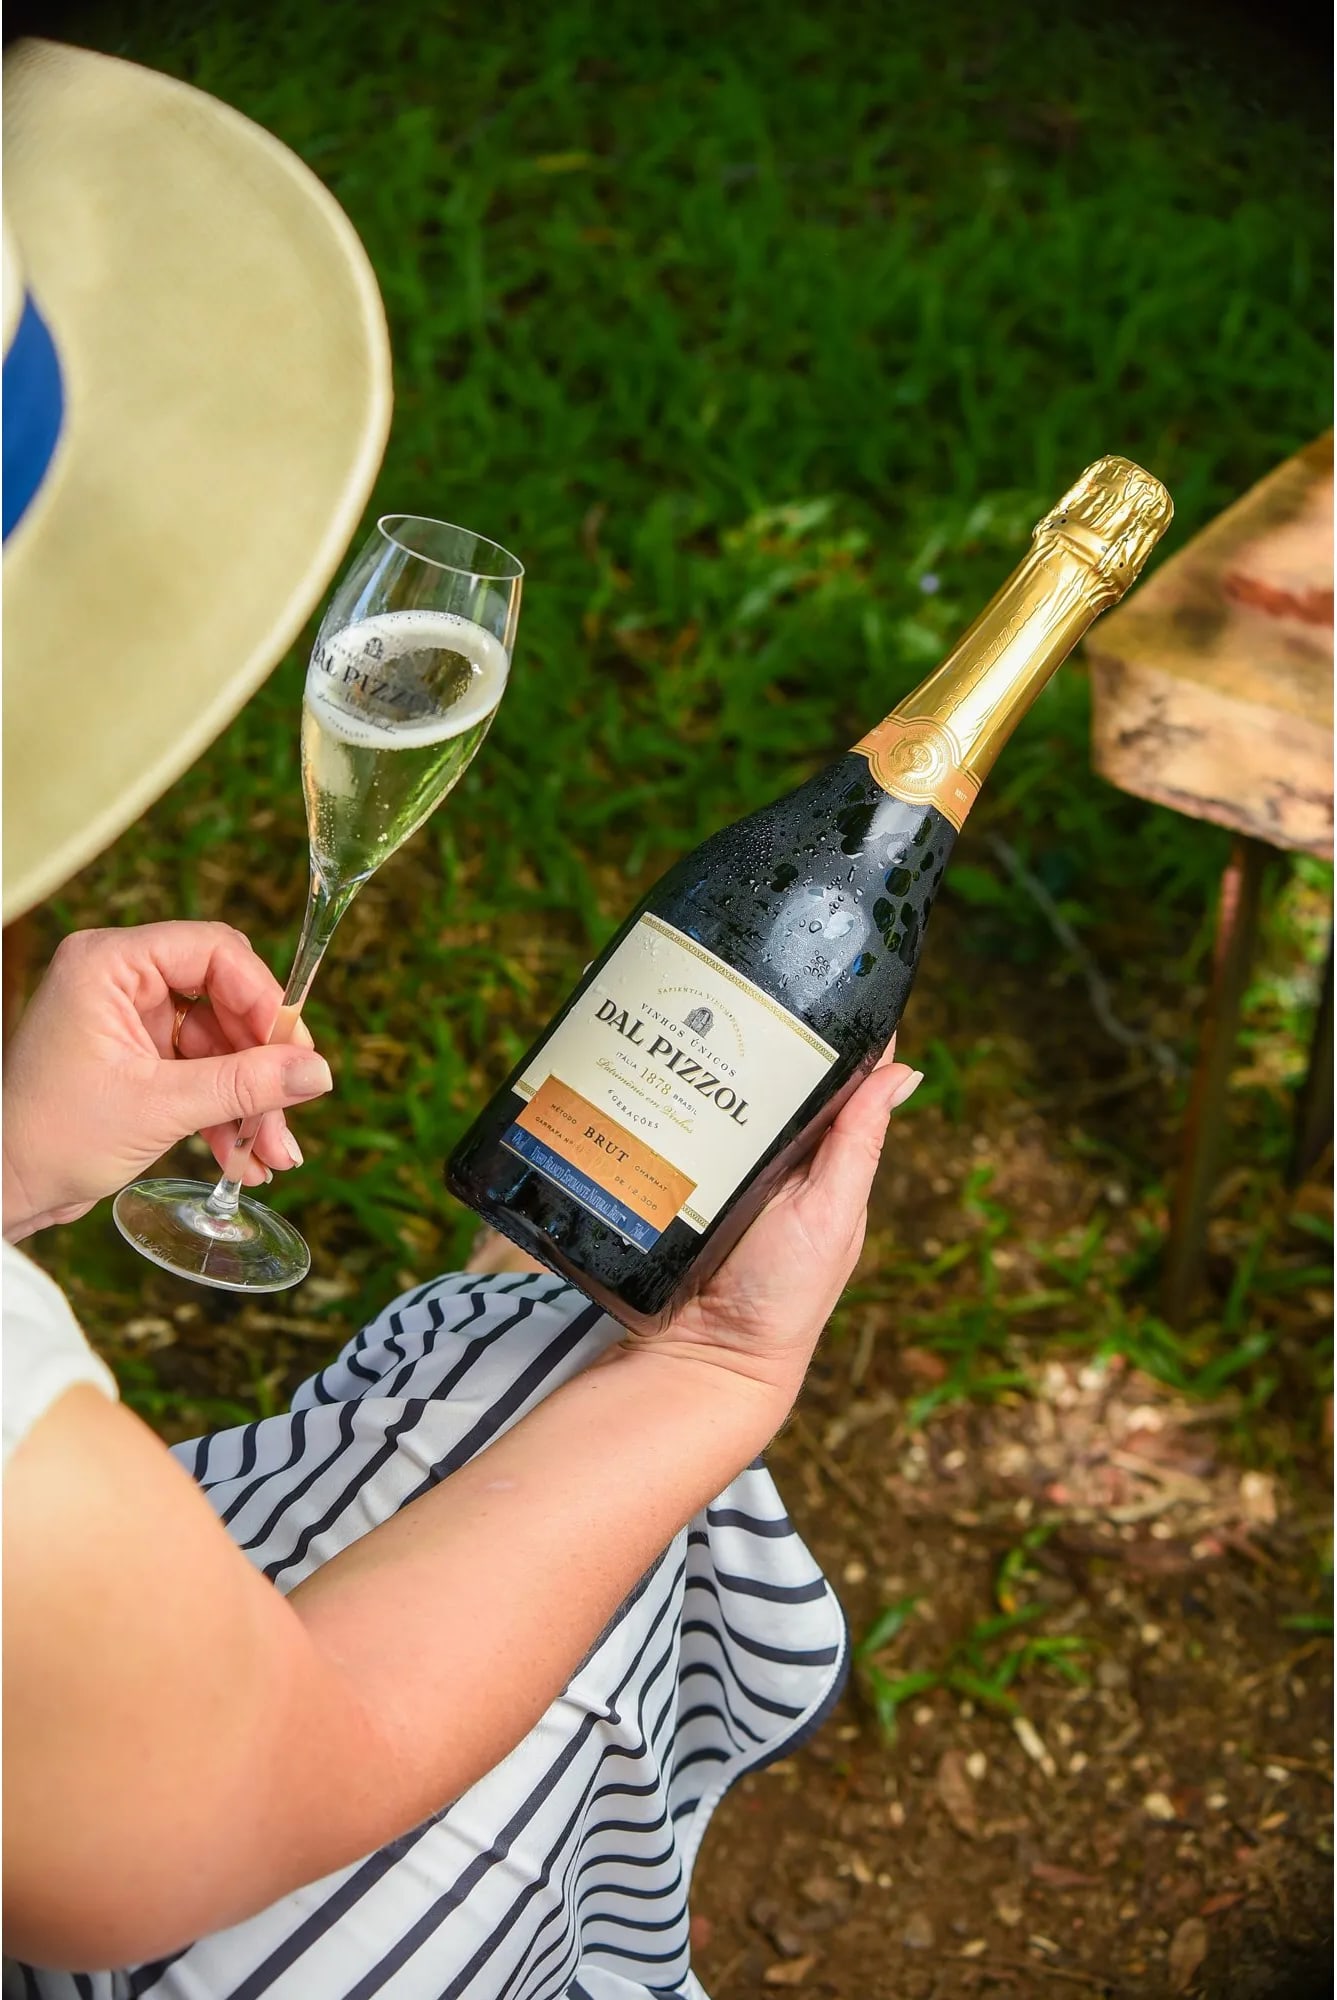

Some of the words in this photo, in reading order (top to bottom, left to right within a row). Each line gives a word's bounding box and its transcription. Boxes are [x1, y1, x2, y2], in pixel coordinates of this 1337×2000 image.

[594, 998, 645, 1046] DAL
[646, 1034, 749, 1126] PIZZOL
[641, 1003, 685, 1038] VINHOS
[690, 1038, 736, 1077] ÚNICOS
[611, 1094, 660, 1130] GERAÇÕES
[615, 1051, 638, 1070] ITÁLIA
[640, 1067, 672, 1095] 1878
[672, 1093, 697, 1116] BRASIL
[583, 1126, 630, 1164] BRUT
